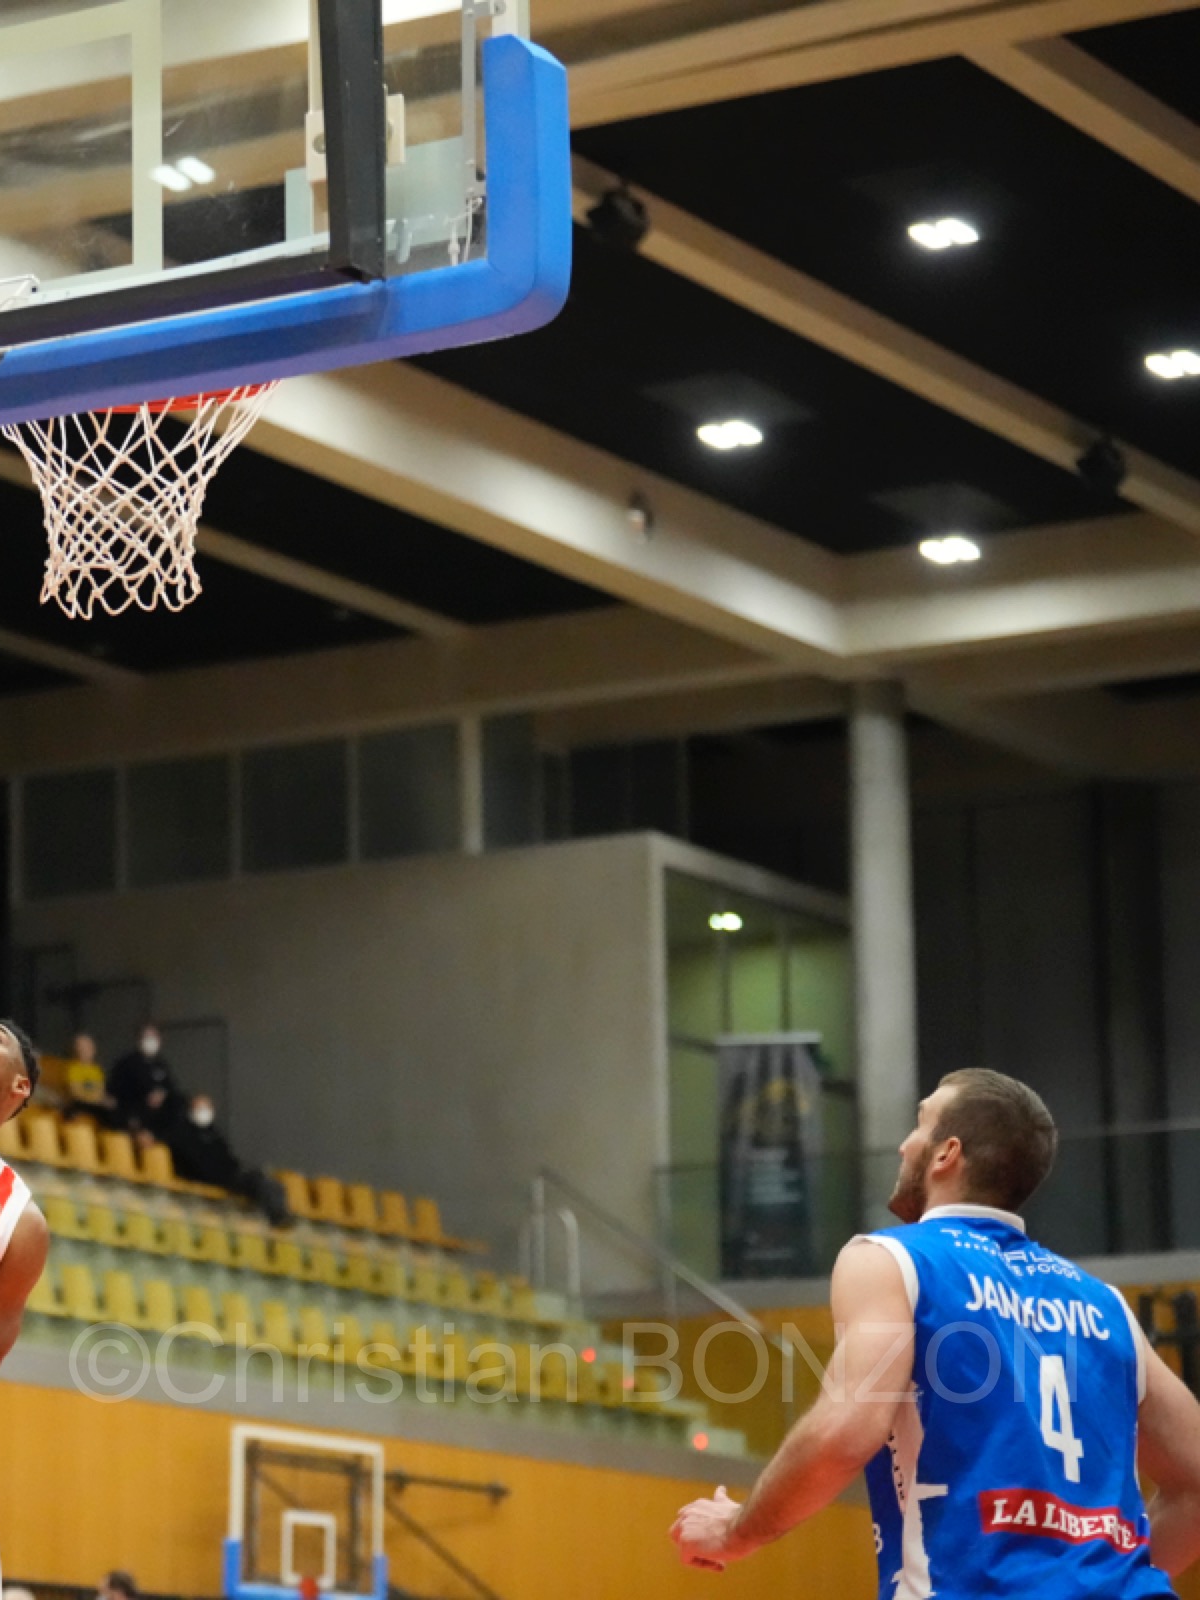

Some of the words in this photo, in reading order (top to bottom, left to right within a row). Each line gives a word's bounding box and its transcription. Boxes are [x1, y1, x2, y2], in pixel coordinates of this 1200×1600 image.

[965, 1273, 1110, 1341] JANKOVIC
[1039, 1354, 1084, 1483] 4
[991, 1499, 1038, 1526] LA
